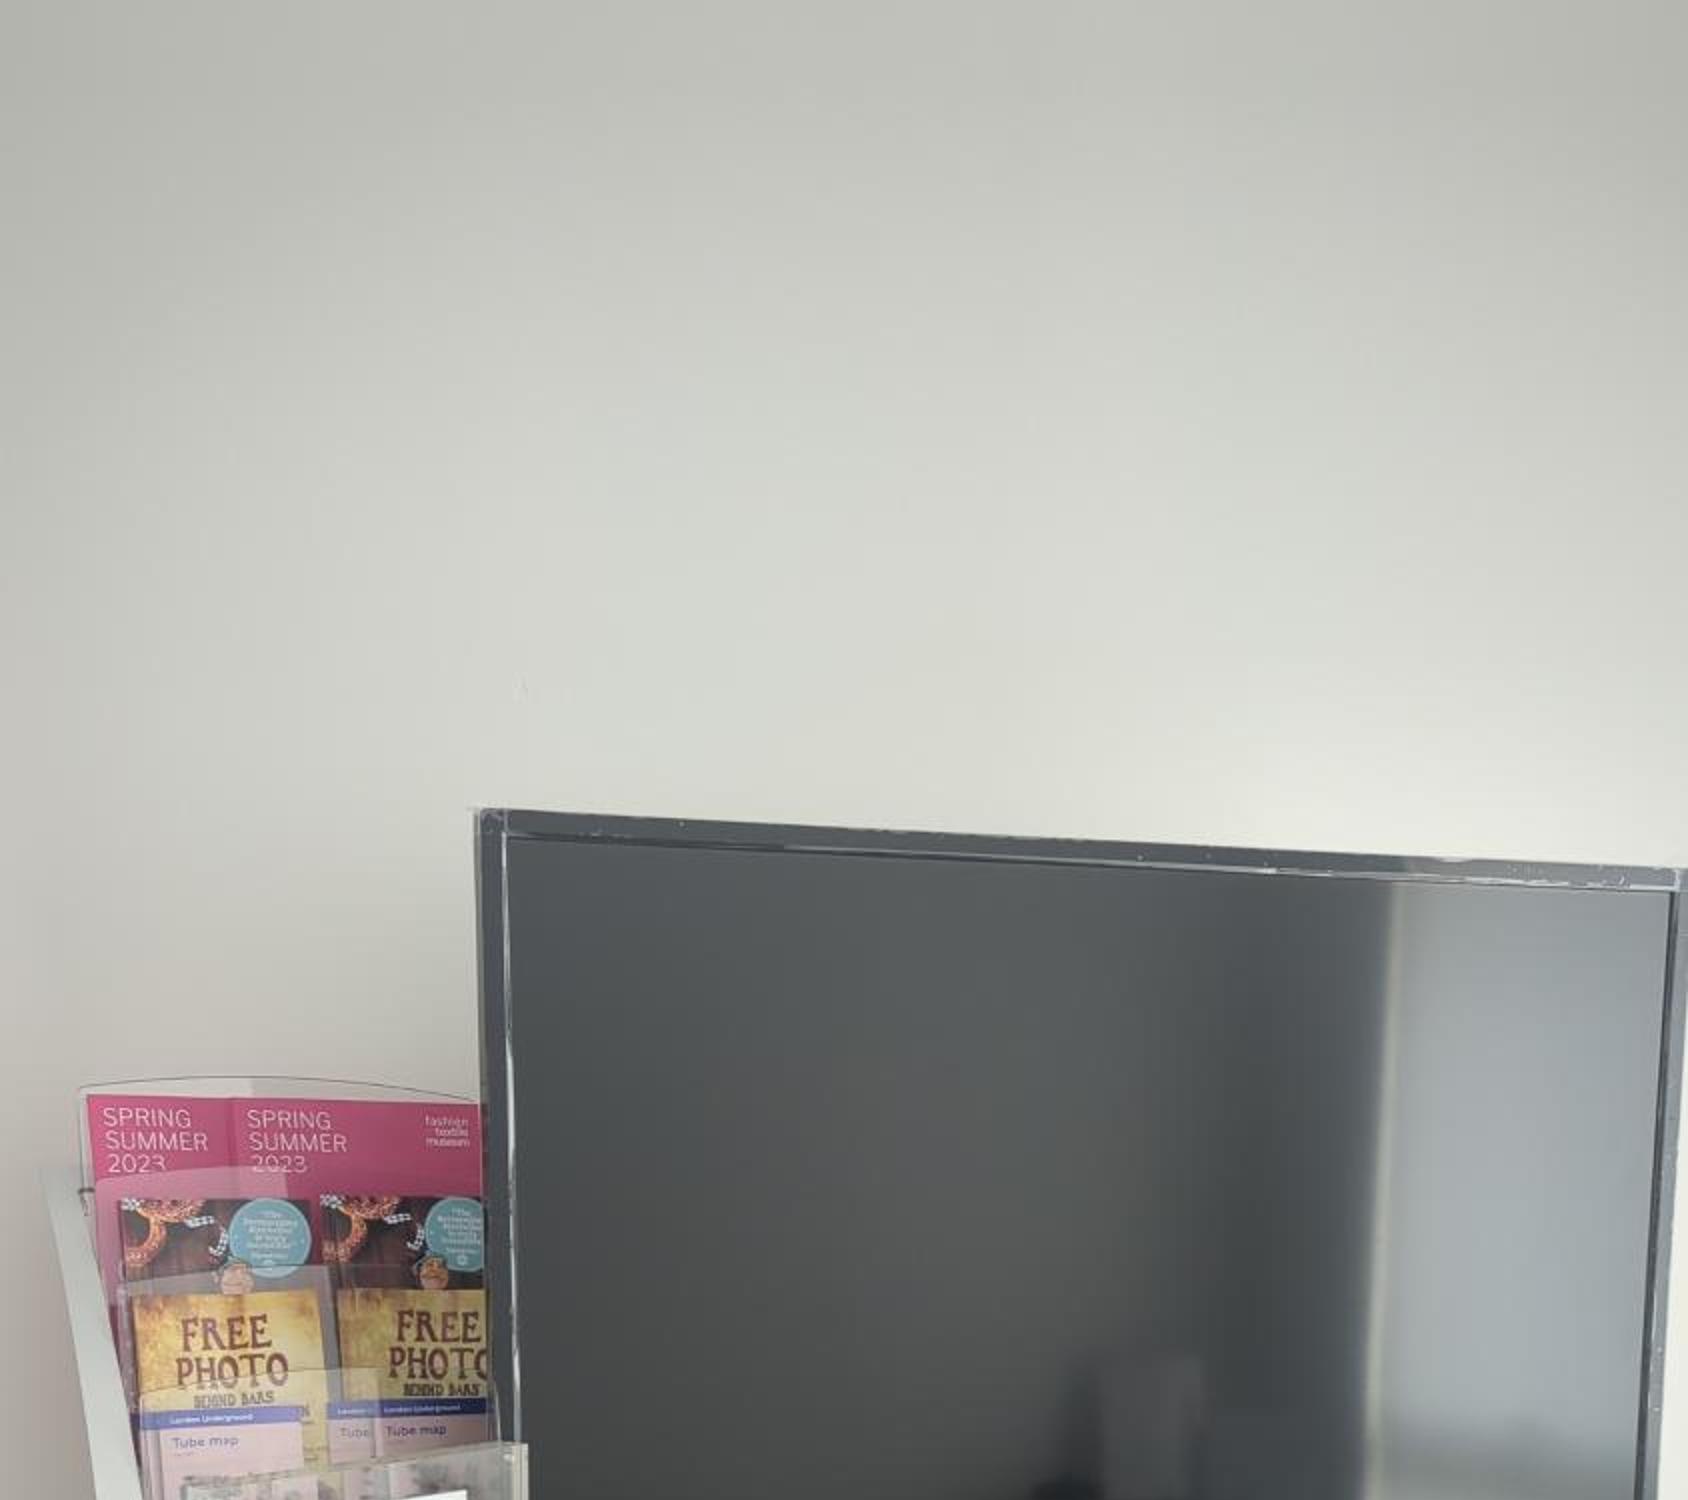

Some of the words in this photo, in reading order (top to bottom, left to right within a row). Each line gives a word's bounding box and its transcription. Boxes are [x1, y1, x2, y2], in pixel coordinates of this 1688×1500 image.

[103, 1107, 191, 1128] SPRING
[247, 1109, 332, 1130] SPRING
[104, 1130, 208, 1151] SUMMER
[249, 1132, 347, 1152] SUMMER
[108, 1153, 166, 1173] 2023
[252, 1154, 307, 1173] 2023
[181, 1313, 272, 1351] FREE
[396, 1309, 482, 1343] FREE
[176, 1352, 289, 1390] PHOTO
[403, 1383, 444, 1396] BEHIND
[448, 1382, 481, 1396] BARS
[386, 1425, 416, 1437] Tube
[419, 1425, 447, 1438] map
[172, 1436, 205, 1449] Tube
[208, 1436, 240, 1448] map
